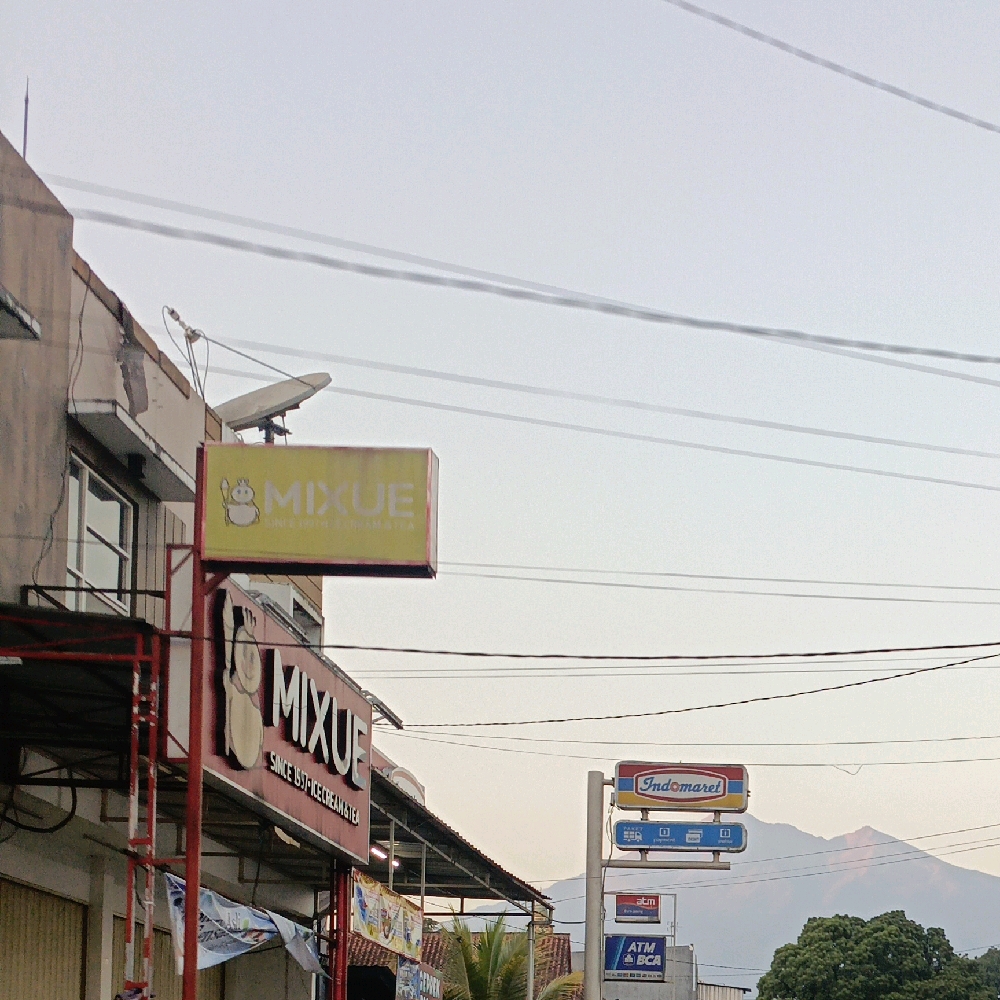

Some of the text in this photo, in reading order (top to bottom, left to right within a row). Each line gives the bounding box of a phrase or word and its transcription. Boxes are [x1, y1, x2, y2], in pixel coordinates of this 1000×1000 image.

[264, 480, 415, 518] MIXUE
[272, 647, 368, 789] MIXUE
[270, 750, 293, 783] SINCE
[639, 776, 722, 794] Indomaret
[636, 896, 656, 906] atm
[627, 941, 656, 953] ATM
[636, 954, 662, 966] BCA
